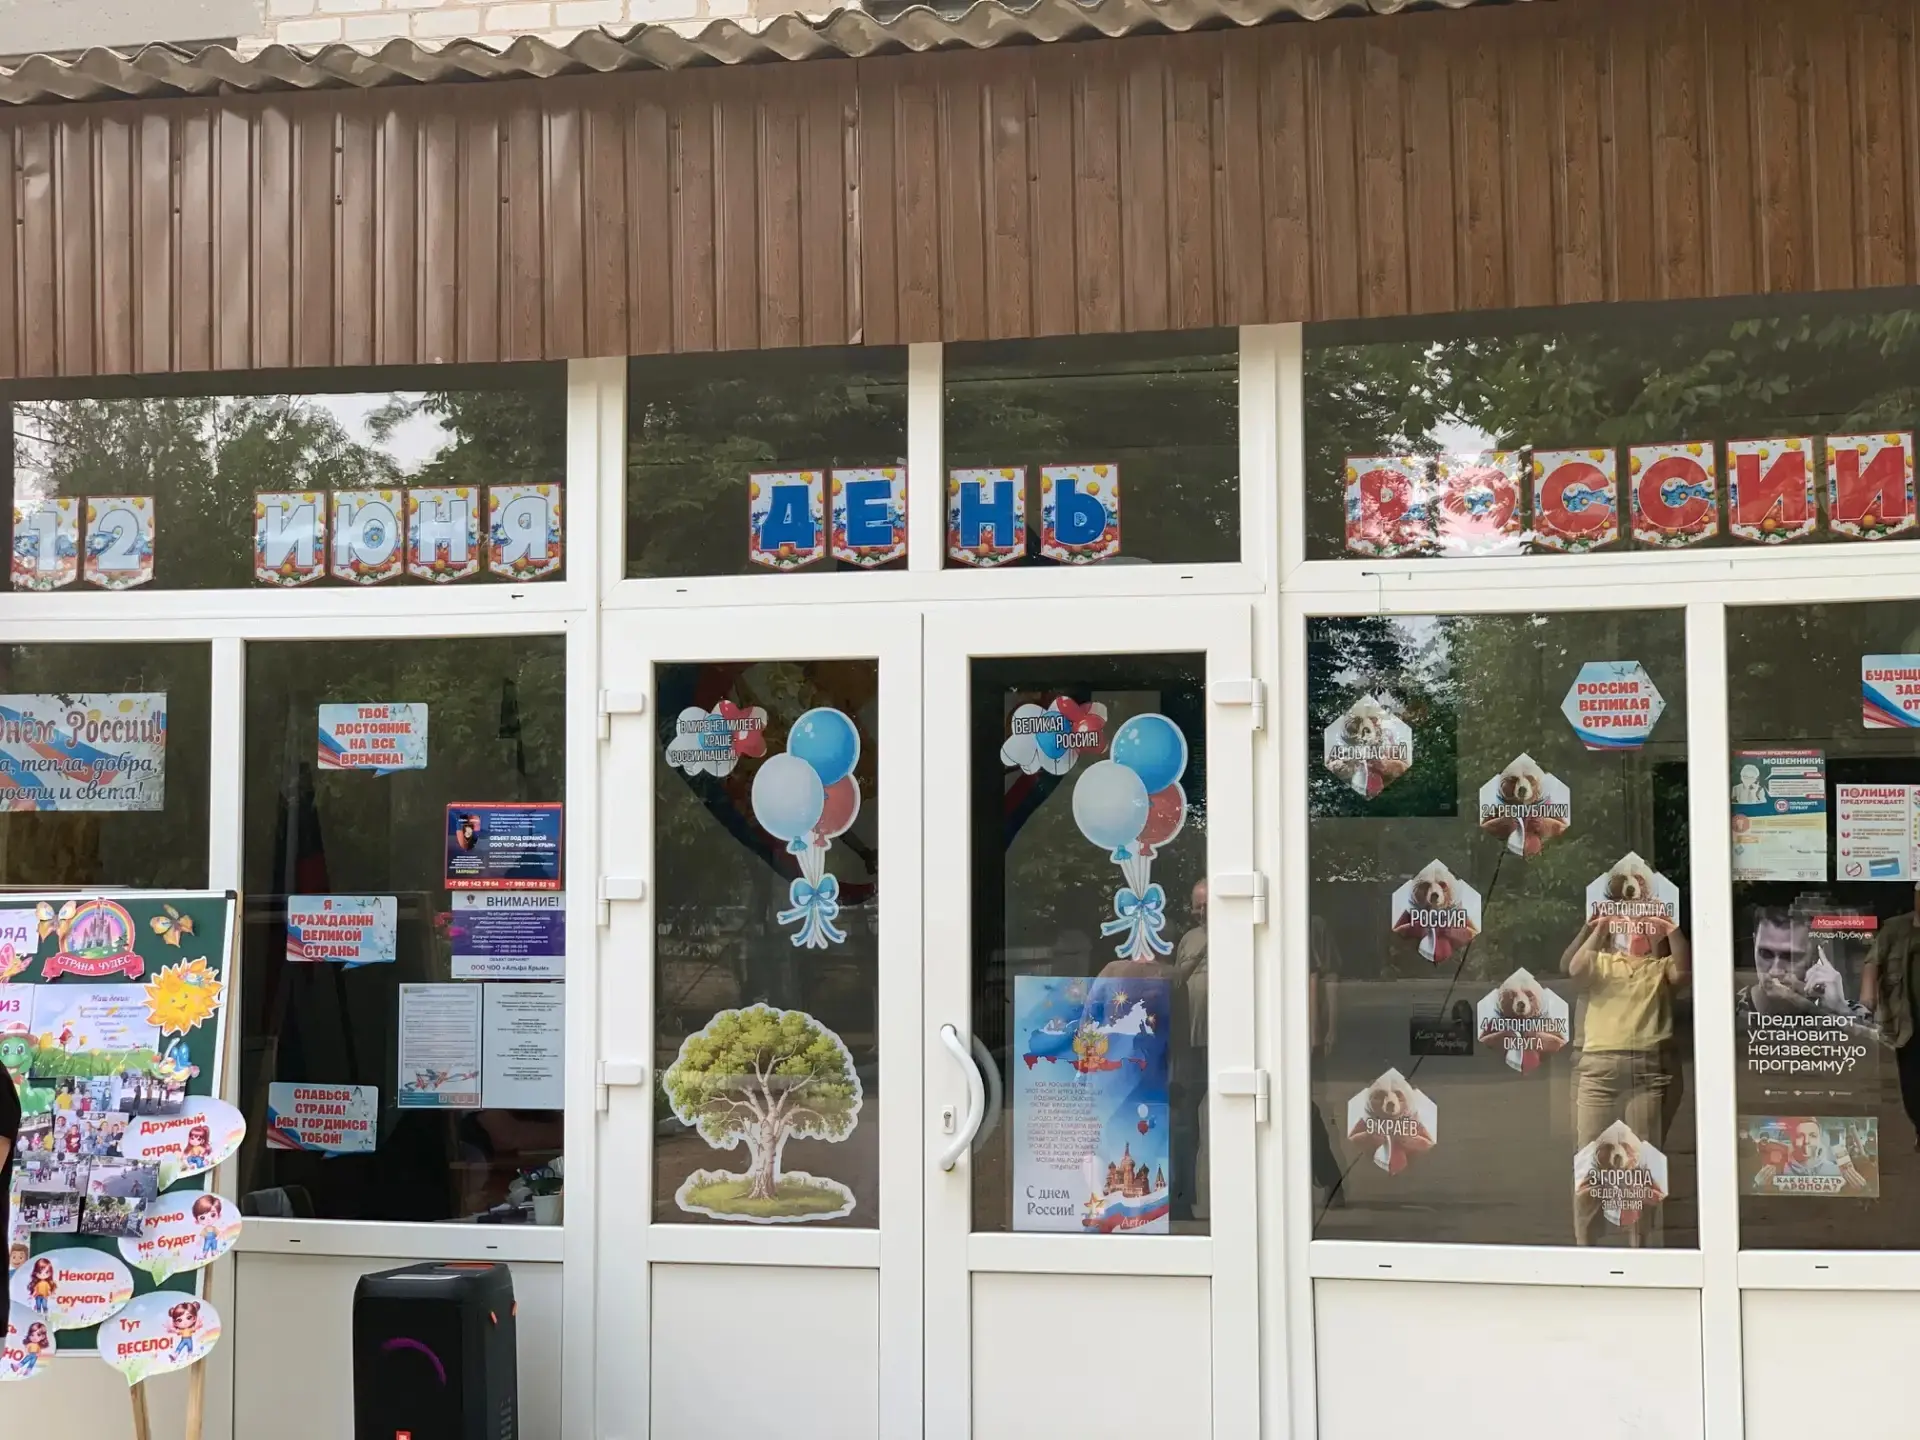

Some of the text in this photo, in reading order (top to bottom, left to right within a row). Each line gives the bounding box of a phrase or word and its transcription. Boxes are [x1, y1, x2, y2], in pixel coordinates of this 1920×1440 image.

[1359, 446, 1906, 539] РОССИИ
[759, 478, 1107, 551] ДЕНЬ
[29, 495, 549, 572] 12 ИЮНЯ
[1865, 668, 1920, 681] БУДУЩ
[1577, 682, 1639, 695] РОССИЯ
[1579, 697, 1650, 711] ВЕЛИКАЯ
[358, 705, 389, 719] ТВОЁ
[681, 718, 761, 733] В МИРЕ НЕТ МИЛЕЕ И
[1015, 716, 1064, 734] ВЕЛИКАЯ
[1582, 714, 1648, 728] СТРАНА!
[66, 709, 162, 748] России!
[335, 722, 412, 736] ДОСТОЯНИЕ
[350, 738, 396, 749] НА ВСЕ
[704, 734, 732, 747] КРАШЕ
[1056, 732, 1099, 748] РОССИЯ!
[671, 750, 703, 763] РОССИИ
[1330, 742, 1408, 760] 48 ОБЛАСТЕЙ
[21, 758, 88, 775] тепла,
[92, 751, 158, 779] добра,
[341, 753, 404, 765] ВРЕМЕНА!
[1762, 757, 1824, 765] МОШЕННИКИ:
[59, 789, 72, 800] и
[76, 781, 144, 801] света!
[1840, 787, 1905, 798] ПОЛИЦИЯ
[1481, 804, 1569, 818] 24 РЕСПУБЛИКИ
[323, 899, 332, 911] Я
[486, 896, 559, 907] ВНИМАНИЕ!
[1591, 901, 1674, 917] 1 АВТОНОМНАЯ
[291, 914, 374, 927] ГРАЖДАНИН
[1410, 909, 1466, 928] РОССИЯ
[302, 928, 362, 941] ВЕЛИКОЙ
[1608, 921, 1657, 935] ОБЛАСТЬ
[1808, 931, 1864, 940] #КладиТрубку
[304, 945, 360, 957] СТРАНЫ
[57, 954, 131, 971] СТРАНА ЧУДЕС
[1480, 1017, 1566, 1032] 4 АВТОНОМНЫХ
[1747, 1011, 1857, 1028] Предлагают
[1503, 1037, 1544, 1050] ОКРУГА
[1747, 1029, 1849, 1044] установить
[1748, 1045, 1867, 1060] неизвестную
[1748, 1058, 1856, 1075] программу?
[294, 1088, 352, 1102] СЛАВЬСЯ,
[295, 1103, 346, 1116] СТРАНА!
[140, 1112, 206, 1136] Дружный
[276, 1116, 368, 1131] МЫ ГОРДИМСЯ
[1366, 1117, 1418, 1136] 9 КРАЁВ
[300, 1131, 342, 1144] ТОБОЙ!
[142, 1142, 182, 1158] отряд
[1589, 1169, 1653, 1188] 3 ГОРОДА
[1026, 1185, 1070, 1200] С днем
[1590, 1188, 1653, 1199] ФЕДЕРАЛЬНОГО
[1027, 1202, 1075, 1217] России!
[1601, 1200, 1643, 1210] ЗНАЧЕНИЯ
[138, 1234, 196, 1253] не будет
[58, 1270, 115, 1283] Некогда
[56, 1294, 106, 1306] скучать
[119, 1318, 141, 1332] Тут
[117, 1337, 174, 1356] ВЕСЕЛО!
